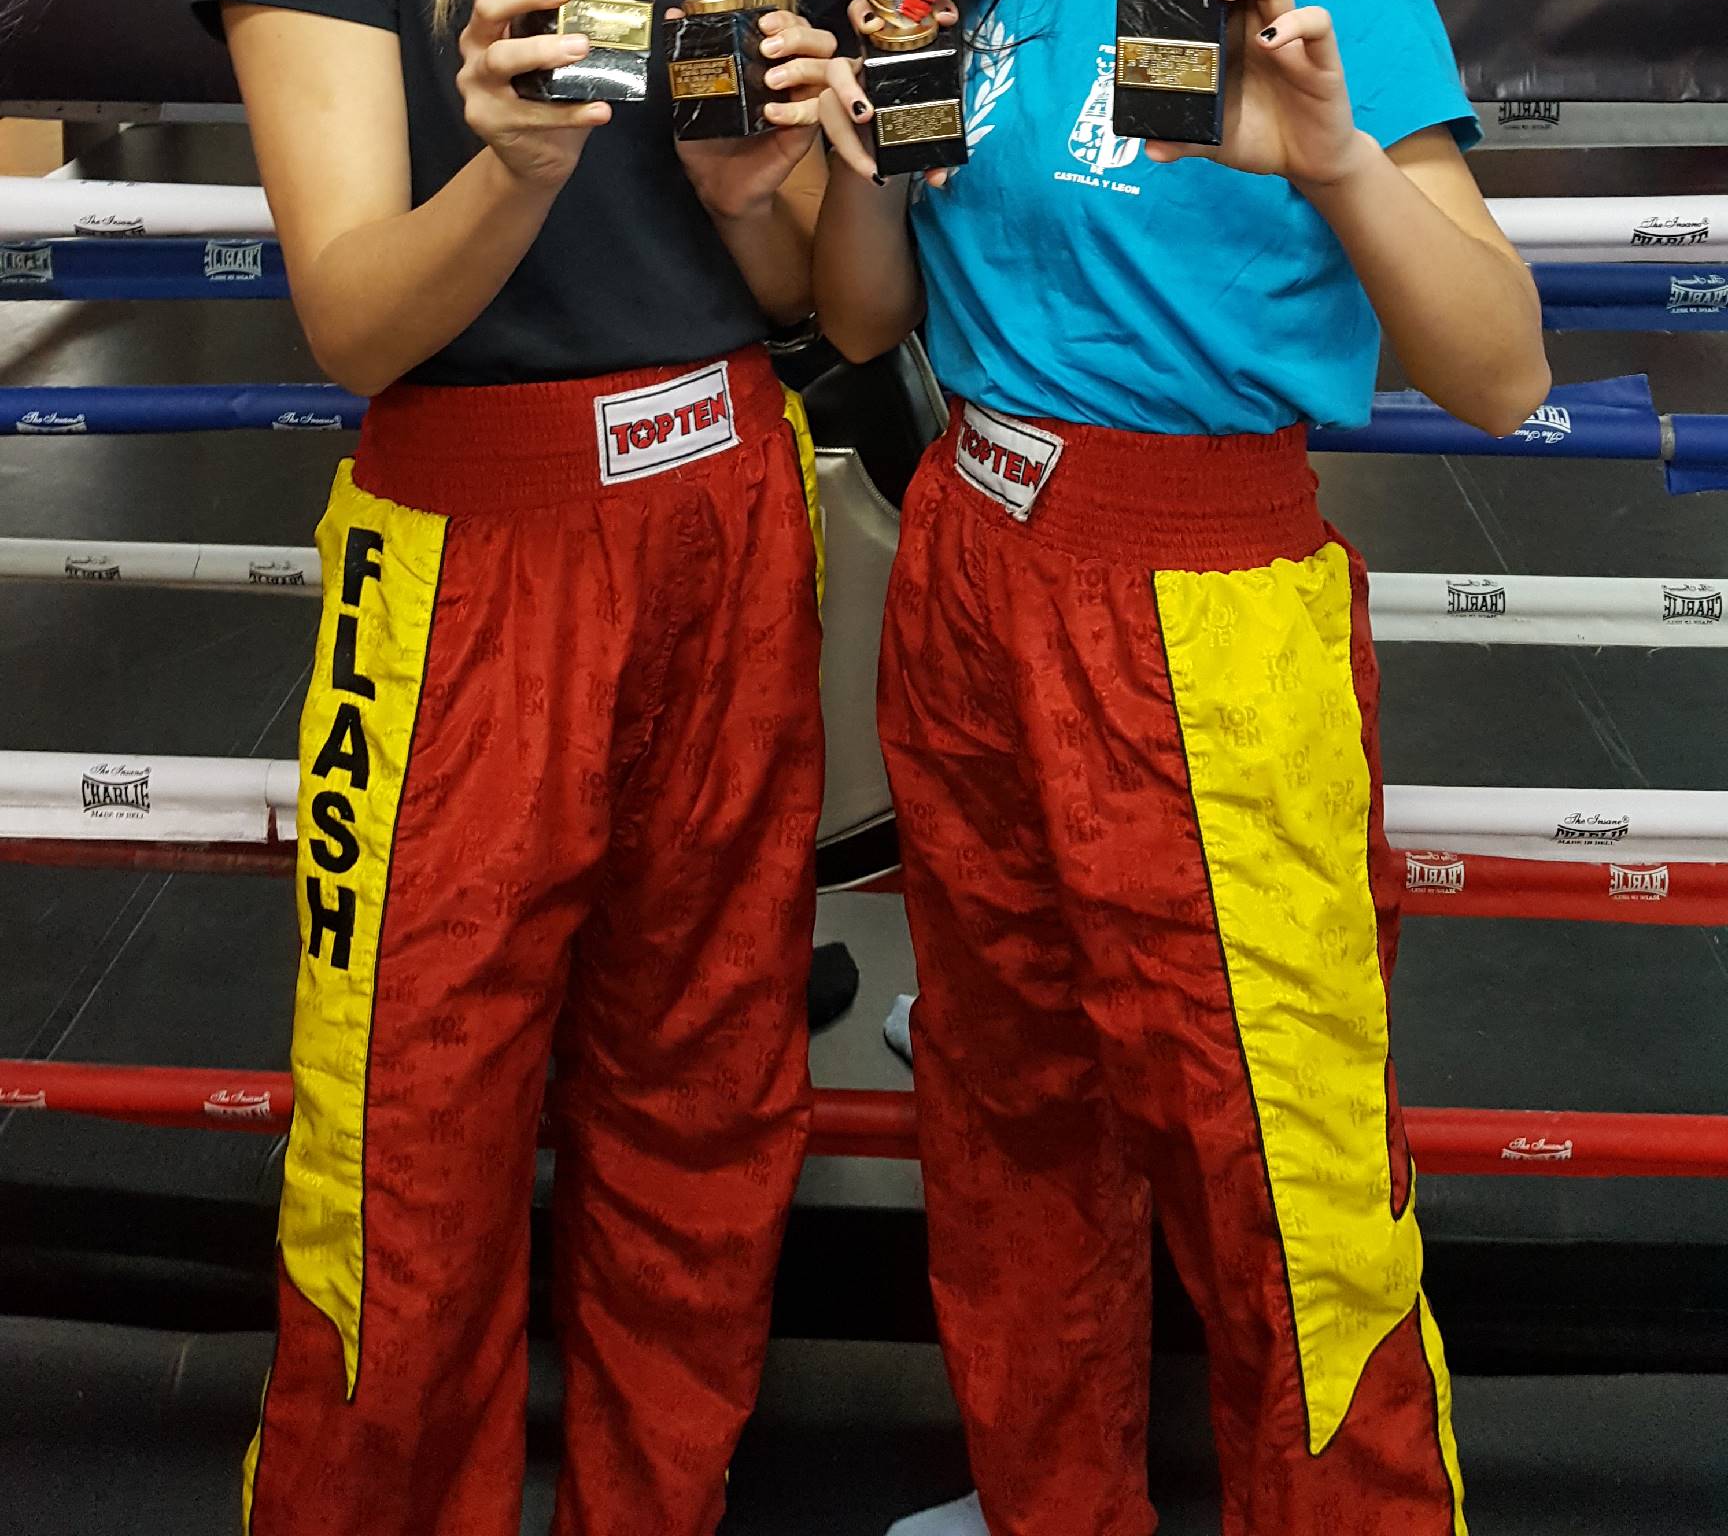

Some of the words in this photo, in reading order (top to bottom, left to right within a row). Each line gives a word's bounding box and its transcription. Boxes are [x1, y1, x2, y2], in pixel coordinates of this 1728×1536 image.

[1053, 171, 1100, 188] CASTILLA
[1101, 178, 1111, 189] Y
[1111, 181, 1141, 196] LEON
[306, 526, 385, 970] FLASH
[82, 779, 151, 808] CHARLIE
[1564, 813, 1586, 825] The
